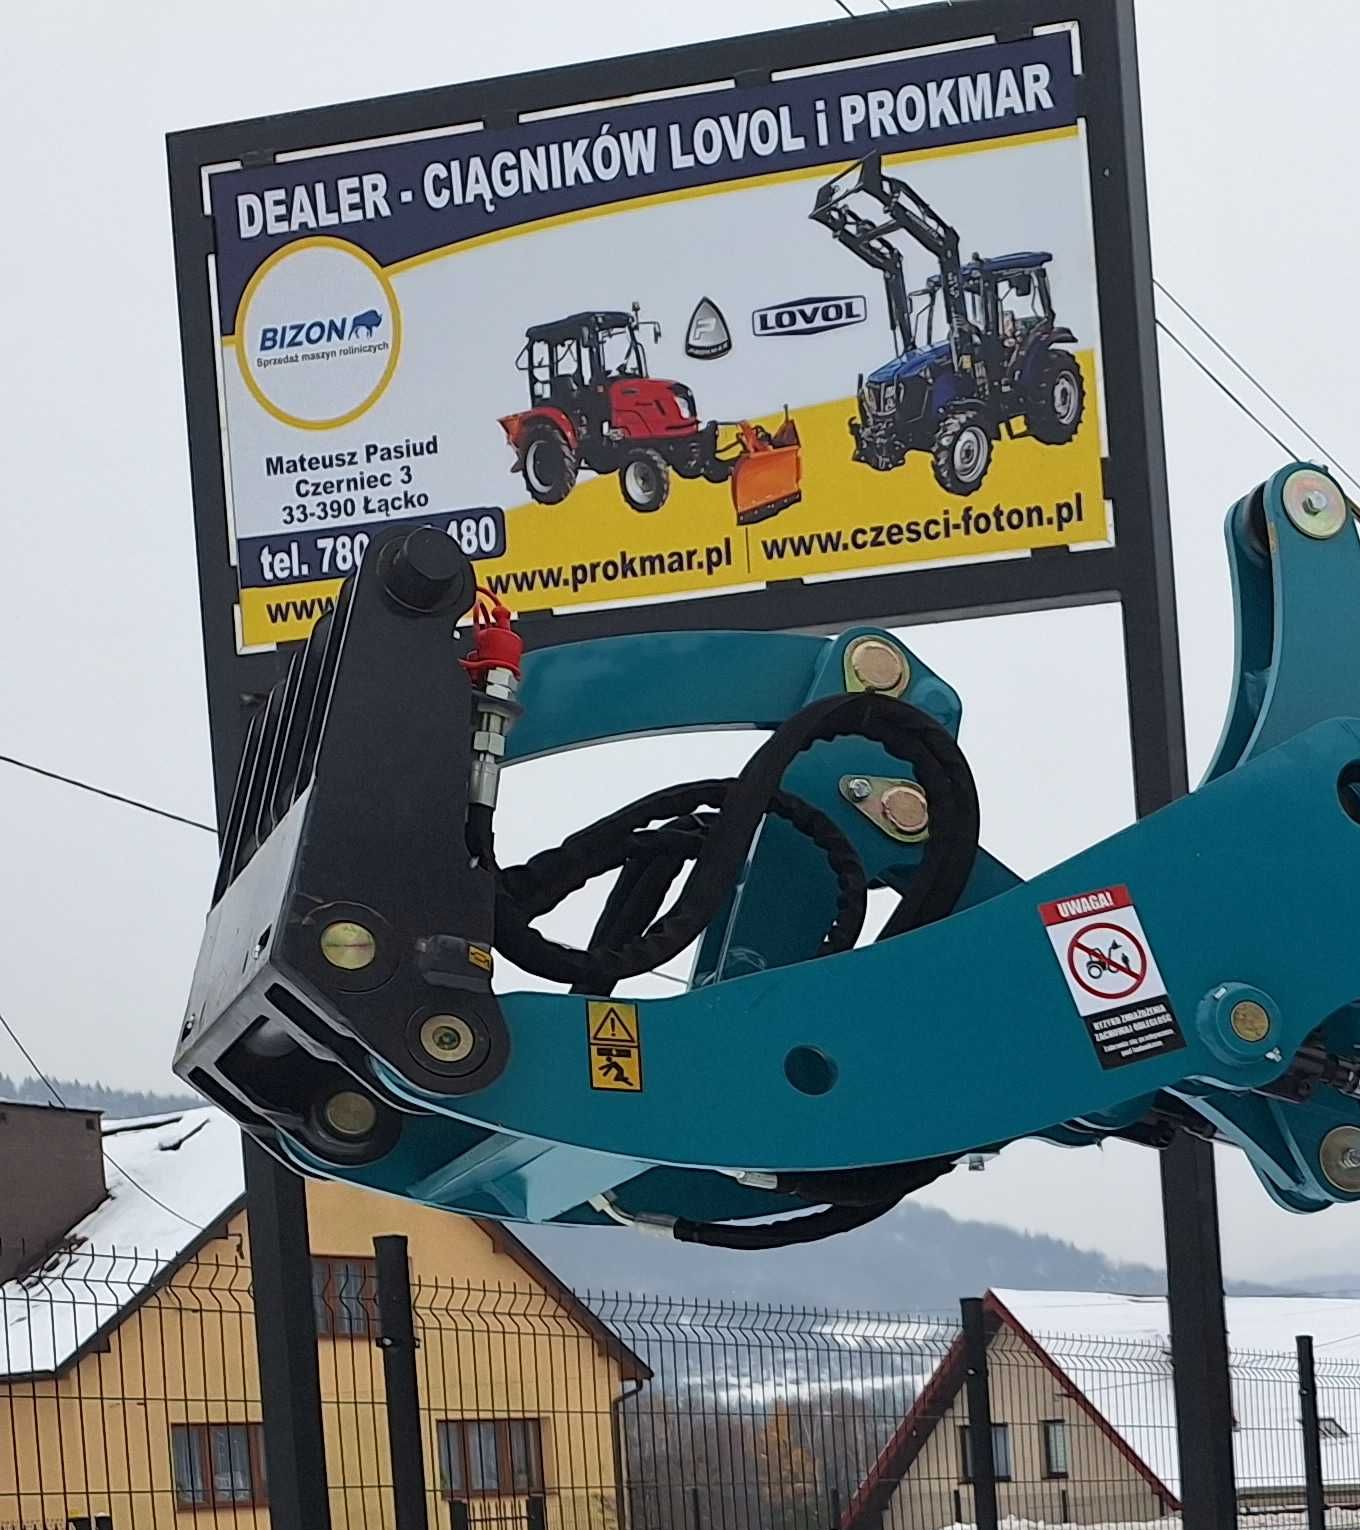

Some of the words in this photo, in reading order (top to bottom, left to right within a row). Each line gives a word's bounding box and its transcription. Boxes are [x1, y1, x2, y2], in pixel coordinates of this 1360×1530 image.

[236, 173, 392, 240] DEALER
[423, 123, 657, 214] CIĄGNIKÓW
[669, 105, 806, 171] LOVOL
[815, 99, 829, 147] i
[840, 63, 1055, 143] PROKMAR
[259, 316, 348, 352] BIZON
[759, 301, 861, 331] LOVOL
[301, 349, 337, 362] maszyn
[265, 449, 358, 477] Mateusz
[365, 435, 439, 465] Pasiud
[295, 471, 392, 499] Czerniec
[400, 465, 413, 485] 3
[281, 499, 357, 526] 33-390
[362, 490, 429, 519] Łącko
[761, 492, 1084, 559] www.czesci-foton.pl
[259, 541, 311, 582] tel.
[487, 536, 732, 594] www.prokmar.pl
[1056, 891, 1114, 918] UWAGA!
